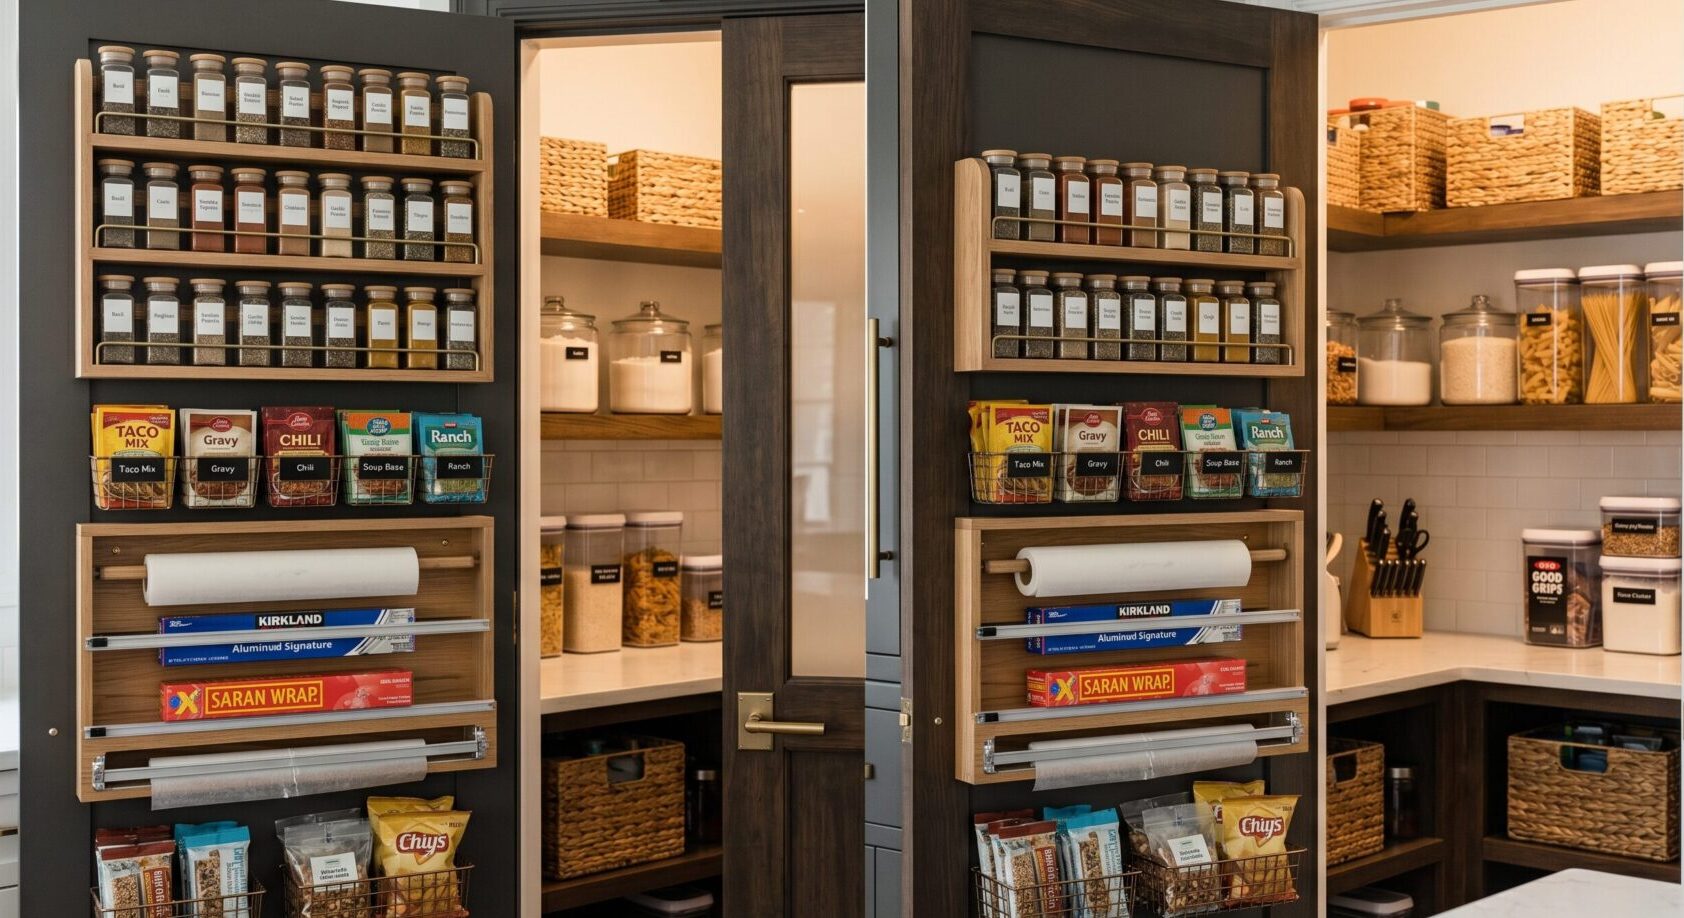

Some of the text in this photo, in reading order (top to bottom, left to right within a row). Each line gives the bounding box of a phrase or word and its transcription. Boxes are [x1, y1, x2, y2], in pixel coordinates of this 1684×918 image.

[115, 425, 159, 438] TACO
[1006, 422, 1040, 434] TACO
[1251, 426, 1284, 439] Ranch
[279, 434, 321, 447] CHILI
[431, 430, 472, 443] Ranch
[1014, 434, 1034, 443] MIX
[1078, 431, 1107, 443] Gravy
[1138, 429, 1170, 441] CHILI
[125, 438, 149, 449] MIX
[203, 435, 239, 448] Gravy
[296, 463, 315, 472] Chili
[363, 463, 404, 473] Soup Base
[448, 462, 471, 470] Ranch
[1014, 459, 1044, 469] Taco Mix
[1087, 460, 1108, 470] Gravy
[1155, 459, 1169, 467] Chili
[1206, 459, 1240, 468] Soup Base
[1274, 458, 1293, 466] Ranch
[119, 464, 156, 474] Taco Mix
[211, 465, 235, 474] Gravy
[1532, 571, 1563, 583] GOOD
[1532, 583, 1563, 595] GRIPS
[1119, 605, 1171, 616] KIRKLAND
[258, 614, 322, 627] KIRKLAND
[1138, 630, 1177, 642] Signature
[284, 640, 333, 653] Signature
[1084, 678, 1129, 695] SARAN
[211, 689, 266, 709] SARAN
